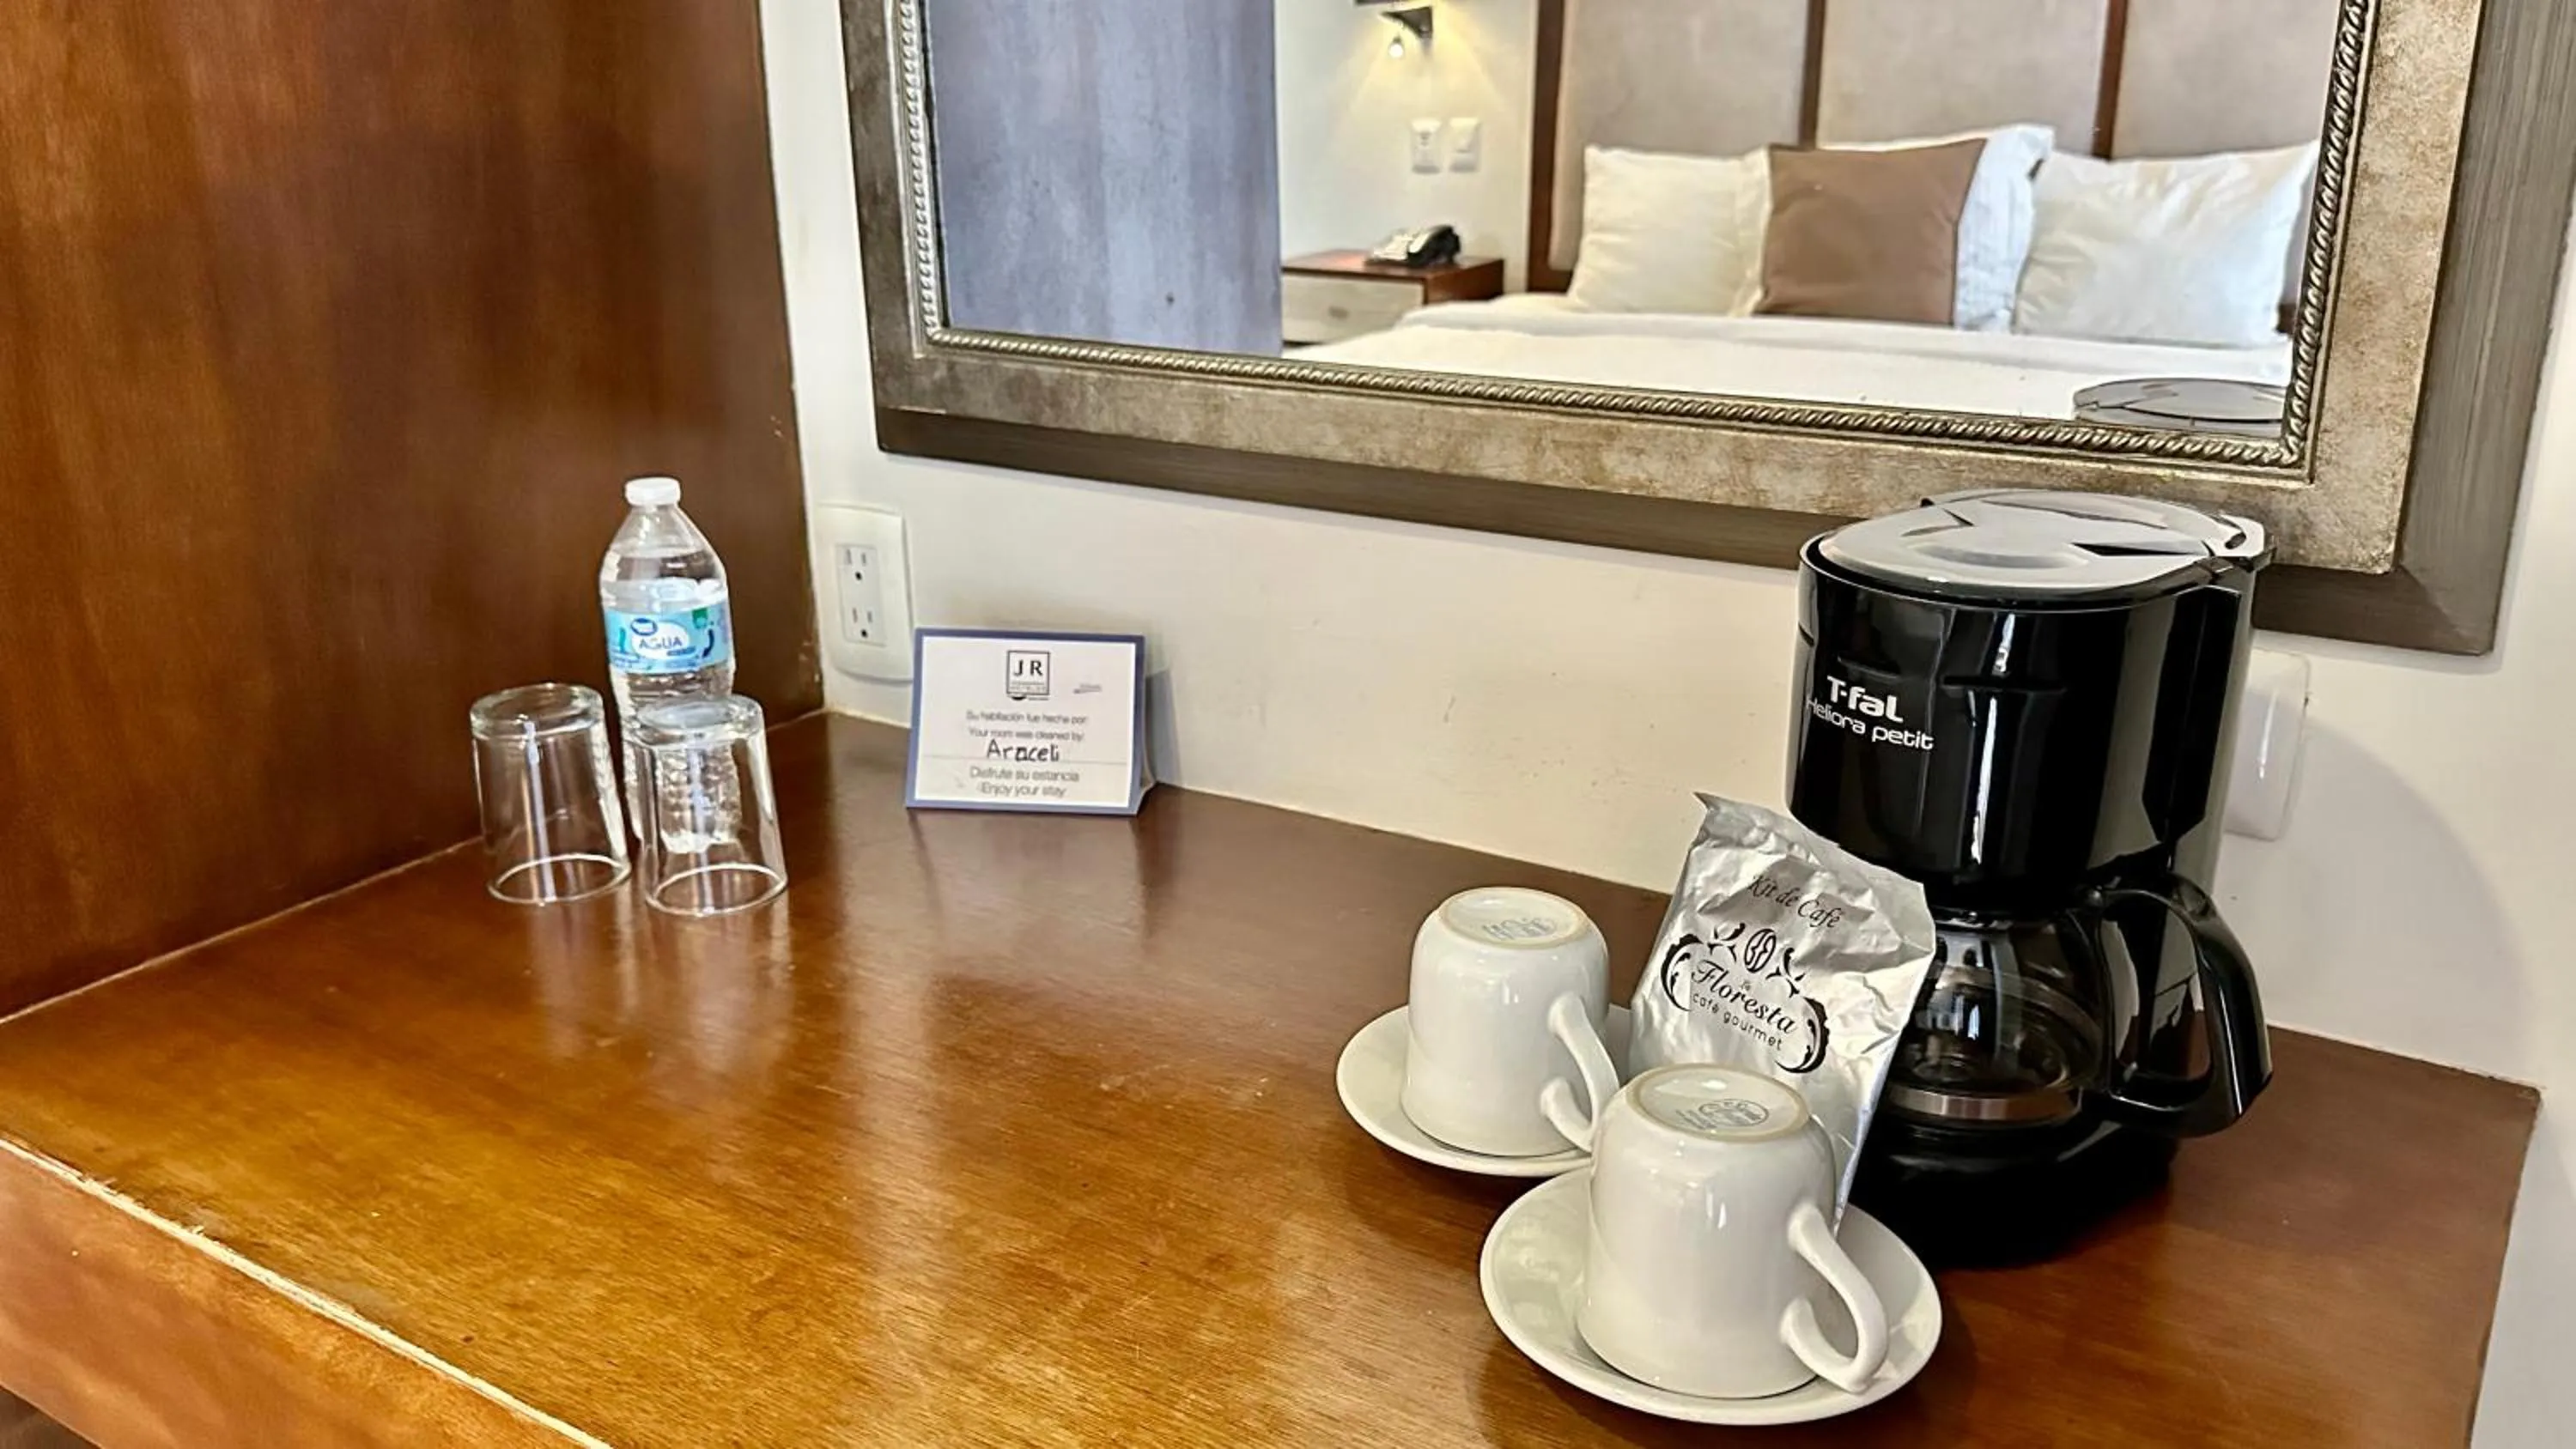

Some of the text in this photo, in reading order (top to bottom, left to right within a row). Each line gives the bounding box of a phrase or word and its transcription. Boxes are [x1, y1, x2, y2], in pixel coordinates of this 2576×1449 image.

[639, 636, 683, 650] AGUA
[1804, 694, 1935, 750] Heliora petit
[987, 739, 1060, 761] Araceli
[1775, 887, 1800, 906] de
[1797, 900, 1845, 927] Café
[1691, 960, 1796, 1034] Floresta
[1723, 1011, 1783, 1050] gourmet
